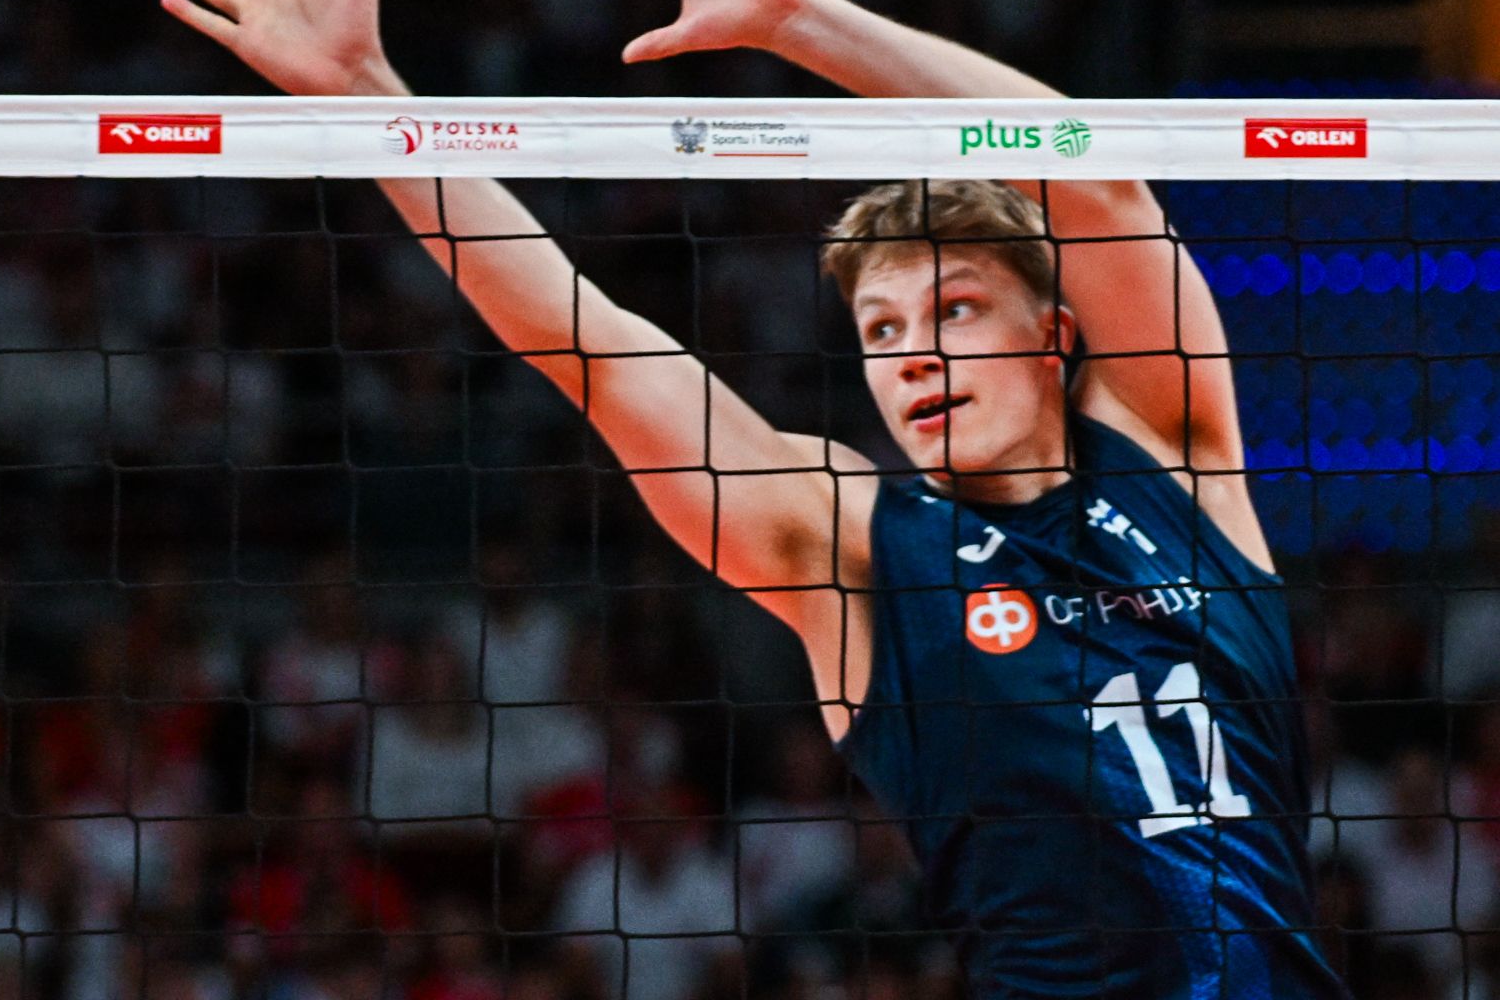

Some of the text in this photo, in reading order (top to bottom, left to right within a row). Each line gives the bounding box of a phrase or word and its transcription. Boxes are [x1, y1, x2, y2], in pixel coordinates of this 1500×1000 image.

[144, 126, 211, 142] ORLEN
[432, 121, 519, 135] POLSKA
[960, 119, 1042, 156] plus
[1290, 130, 1356, 146] ORLEN
[1082, 661, 1251, 839] 11
